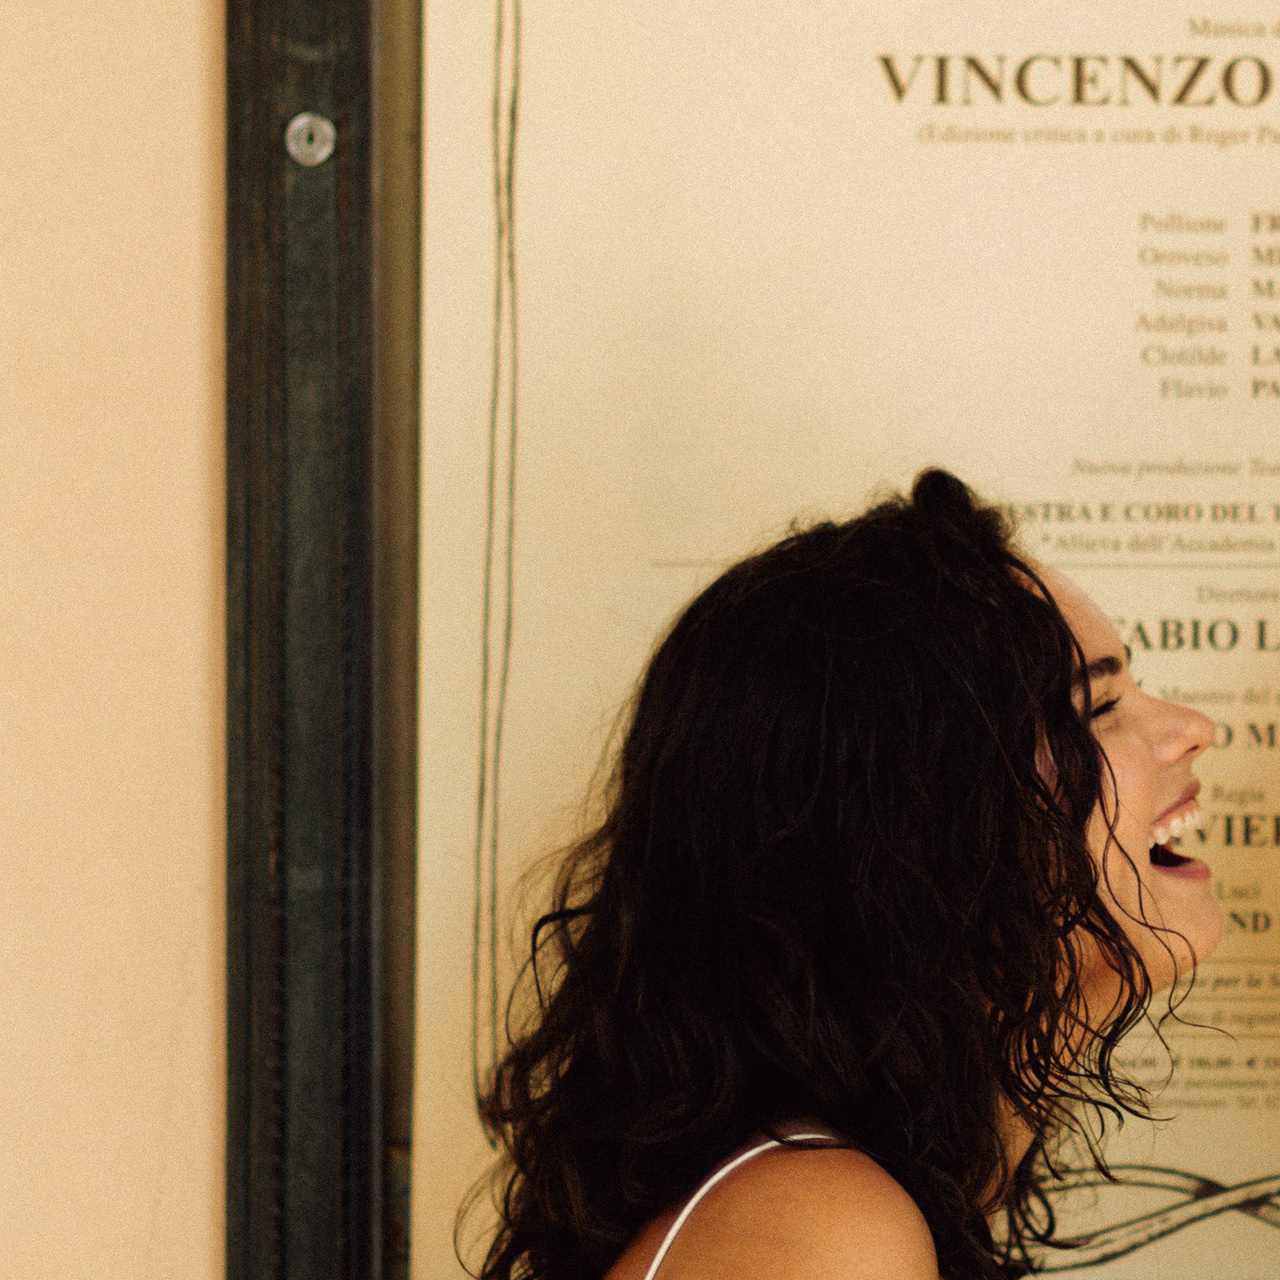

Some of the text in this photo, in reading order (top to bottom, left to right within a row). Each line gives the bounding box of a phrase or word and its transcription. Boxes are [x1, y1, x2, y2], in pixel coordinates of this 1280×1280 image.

[1186, 17, 1267, 39] Musica
[879, 55, 1273, 106] VINCENZO
[1188, 124, 1251, 150] Roger
[1154, 278, 1229, 301] Norma
[1134, 312, 1229, 338] Adalgisa
[1139, 344, 1228, 367] Clotilde
[1159, 377, 1229, 399] Flavio
[1137, 458, 1242, 480] produzione
[1100, 502, 1113, 522] E
[1123, 503, 1204, 523] CORO
[1210, 502, 1260, 523] DEL
[1112, 618, 1244, 652] ABIO
